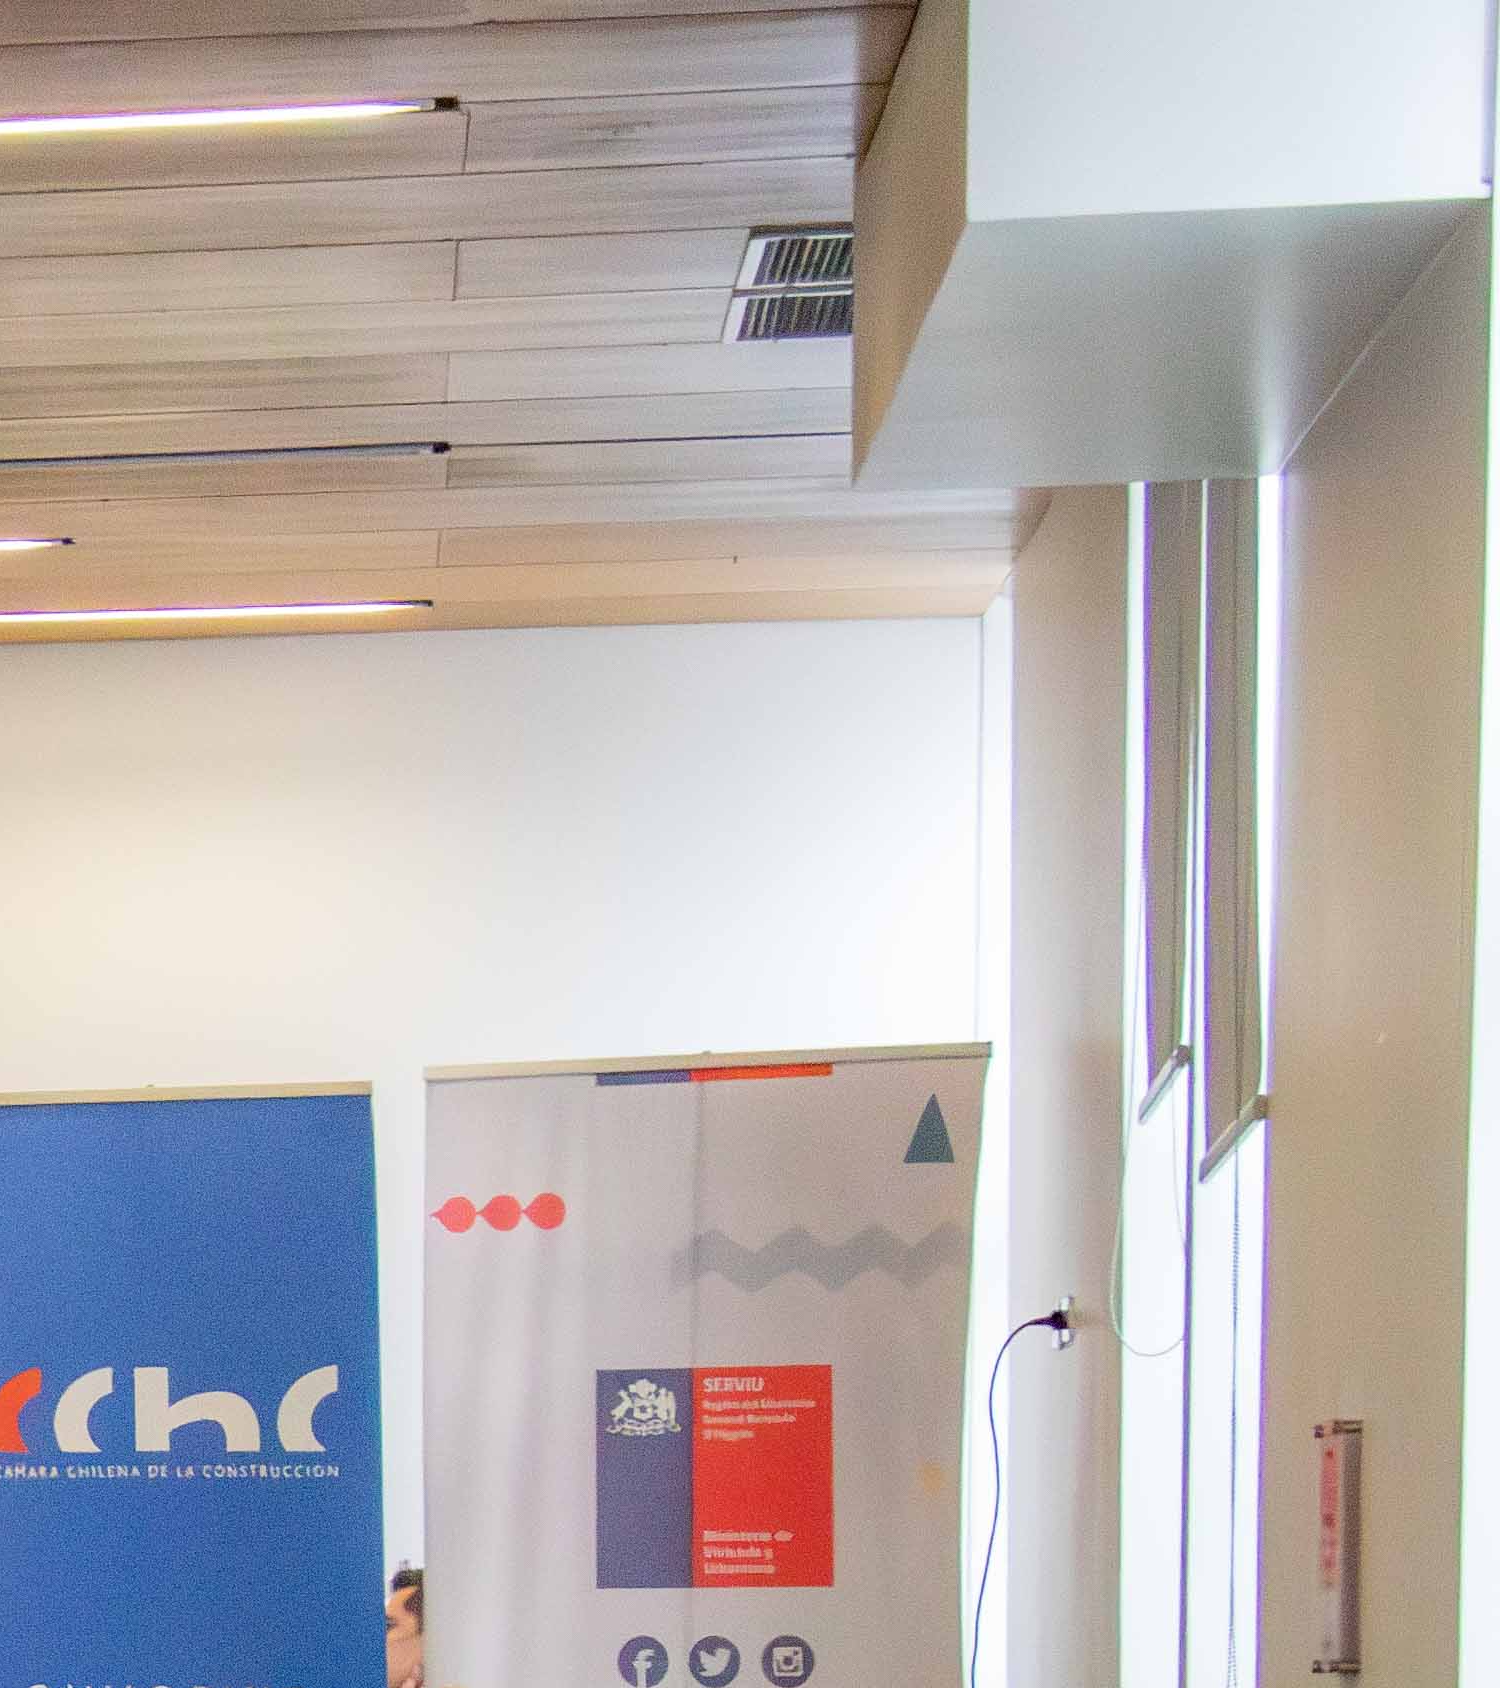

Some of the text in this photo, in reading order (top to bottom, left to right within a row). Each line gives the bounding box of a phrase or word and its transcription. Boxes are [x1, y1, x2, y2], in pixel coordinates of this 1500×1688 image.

[703, 1377, 765, 1393] SERVIU
[66, 1463, 141, 1478] CHILENA
[148, 1463, 169, 1478] DE
[176, 1463, 196, 1478] LA
